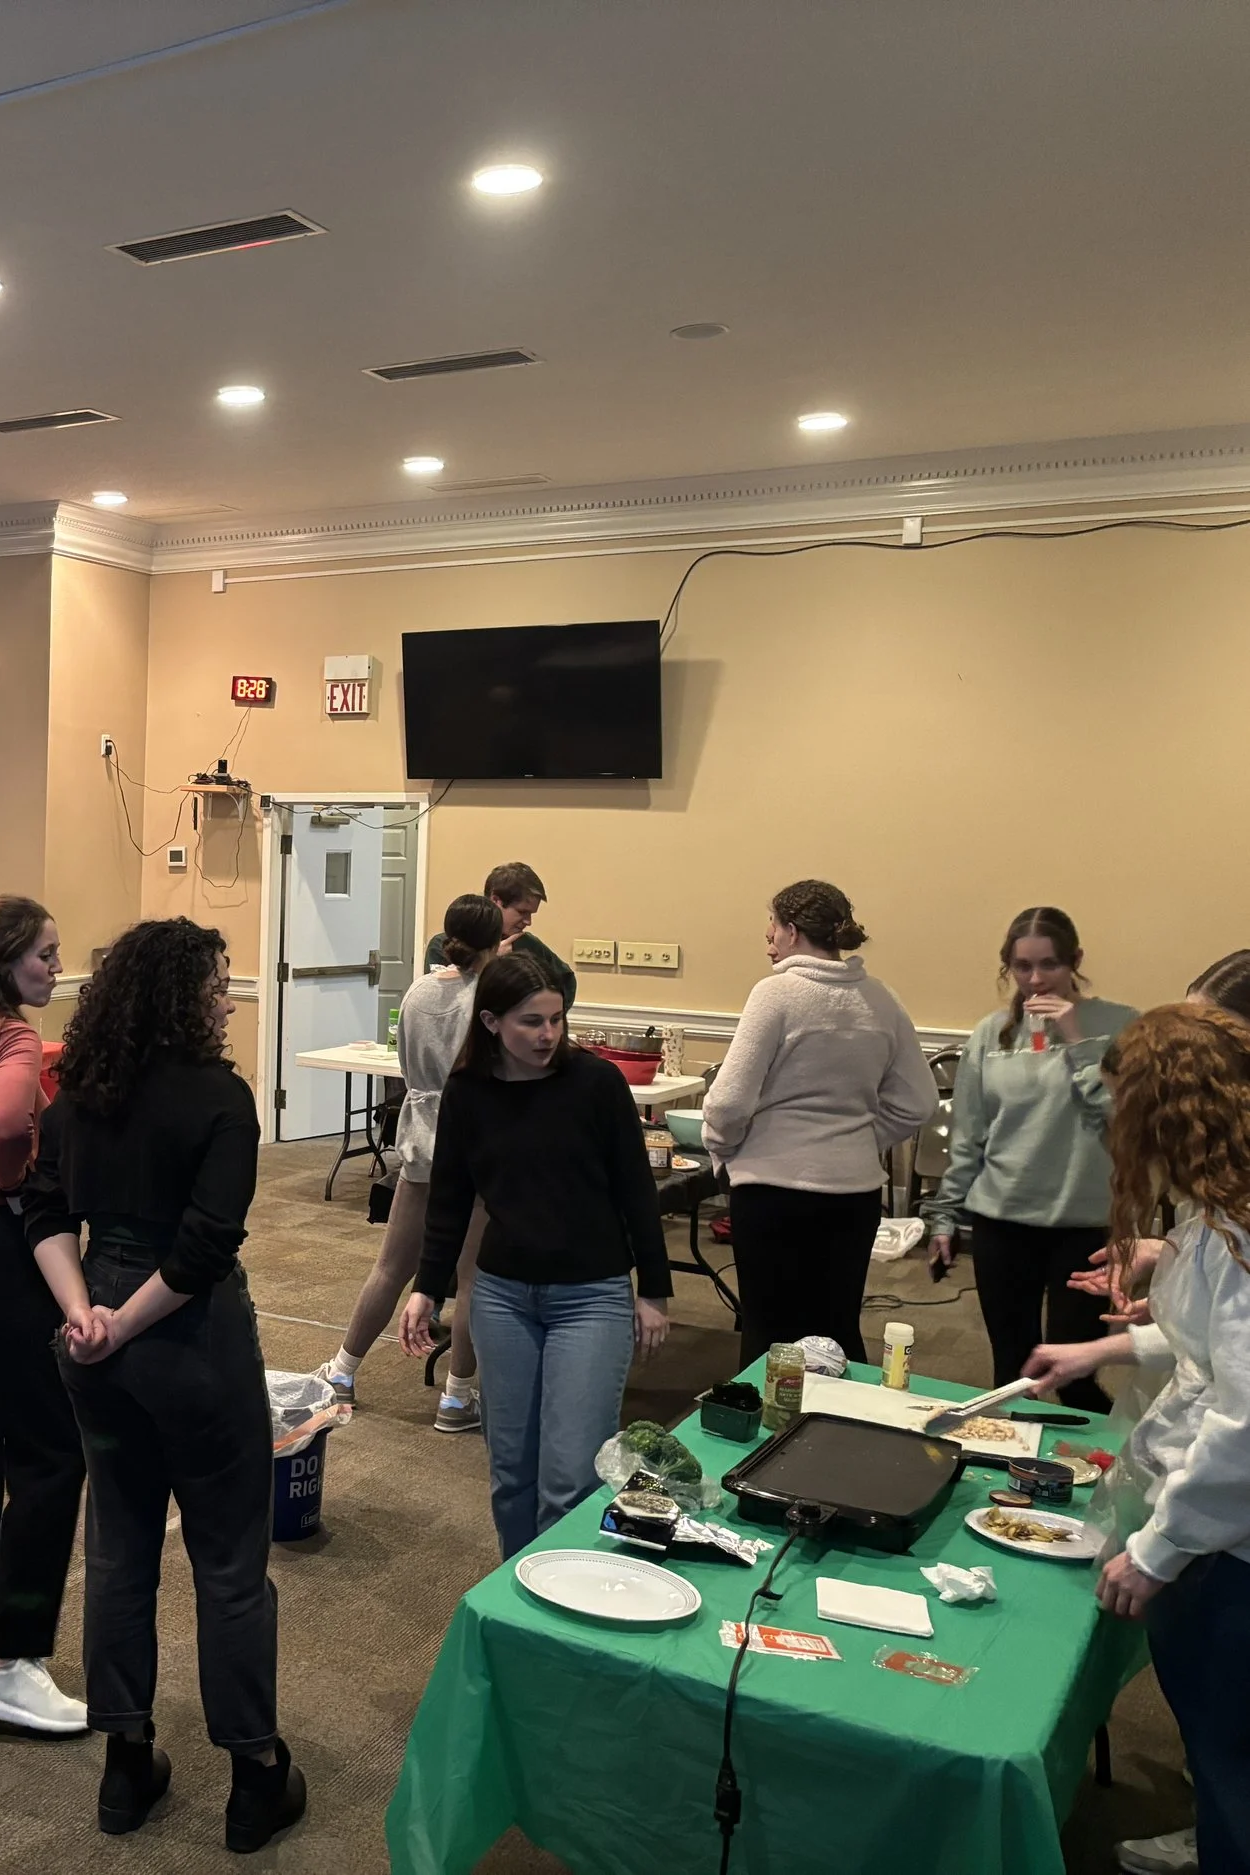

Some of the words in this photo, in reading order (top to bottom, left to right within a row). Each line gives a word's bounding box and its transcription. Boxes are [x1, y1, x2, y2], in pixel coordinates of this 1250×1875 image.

[237, 679, 267, 698] 8:28
[330, 683, 366, 712] EXIT
[291, 1455, 318, 1478] DO
